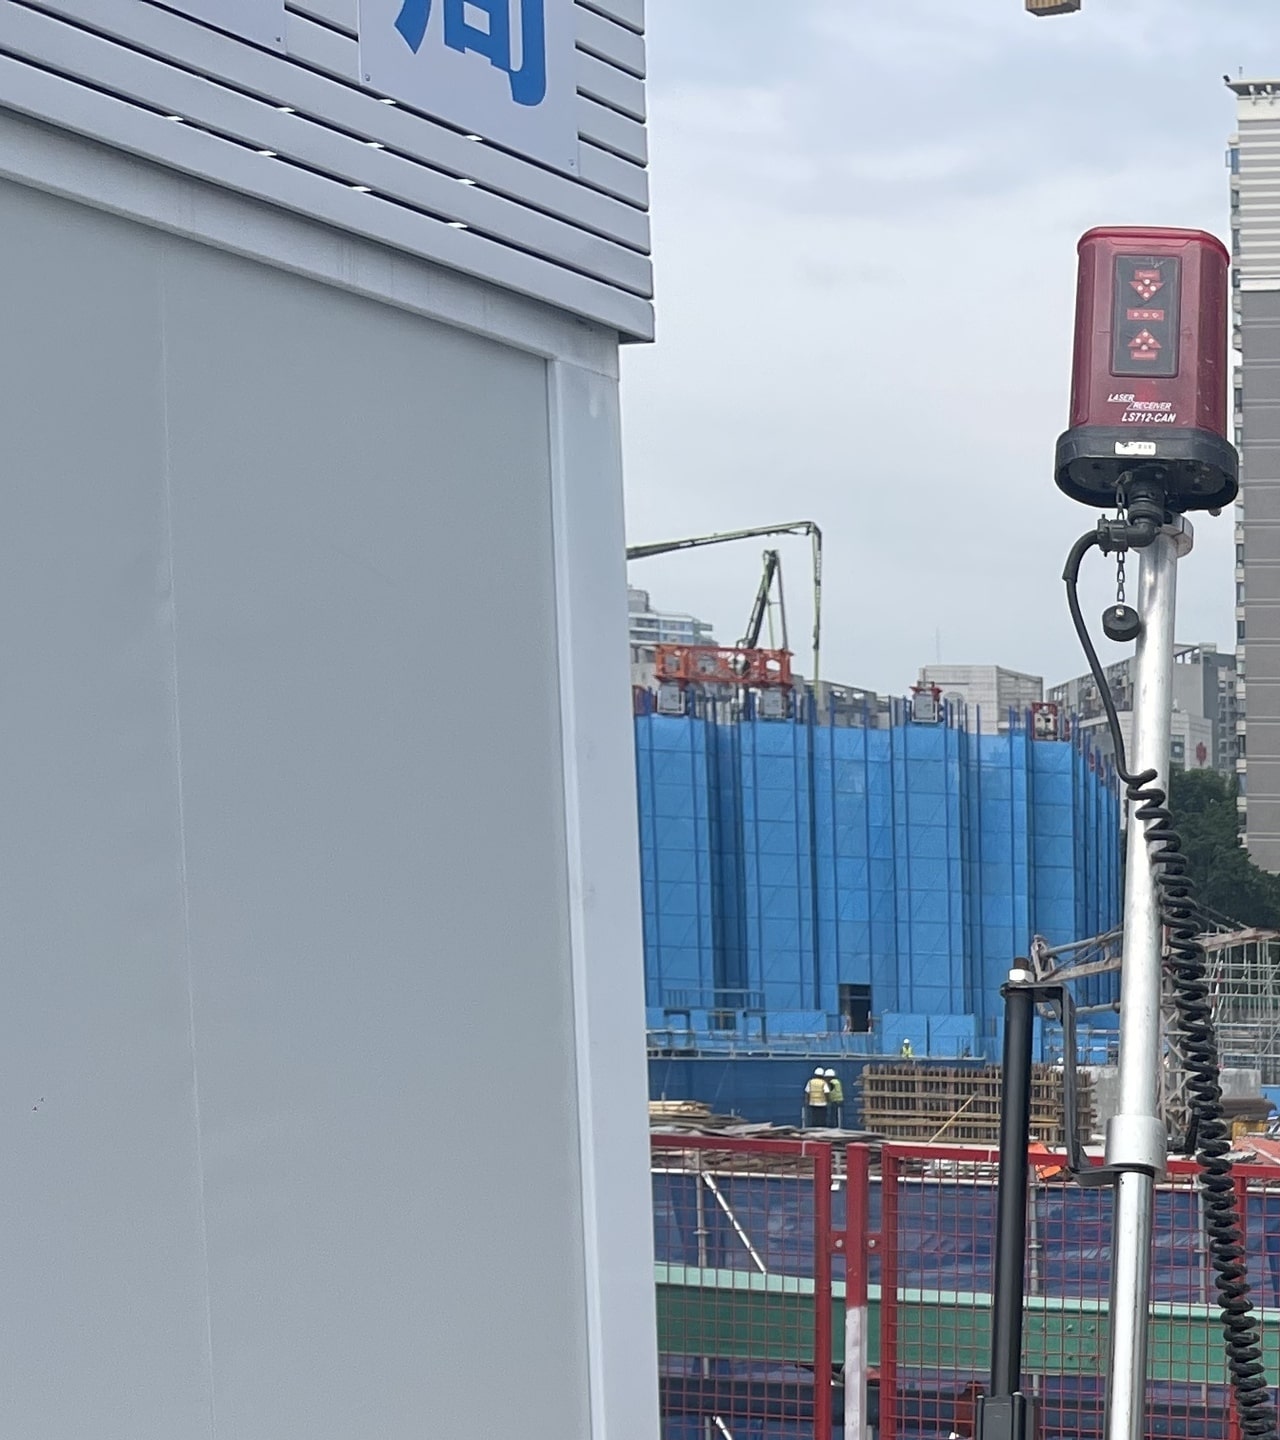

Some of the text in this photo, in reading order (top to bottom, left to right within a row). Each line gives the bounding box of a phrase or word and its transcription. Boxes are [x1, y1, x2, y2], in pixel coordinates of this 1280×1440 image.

[1107, 393, 1135, 402] LASER
[1131, 401, 1172, 411] RECEIVER
[1121, 412, 1176, 422] LS712-CAN
